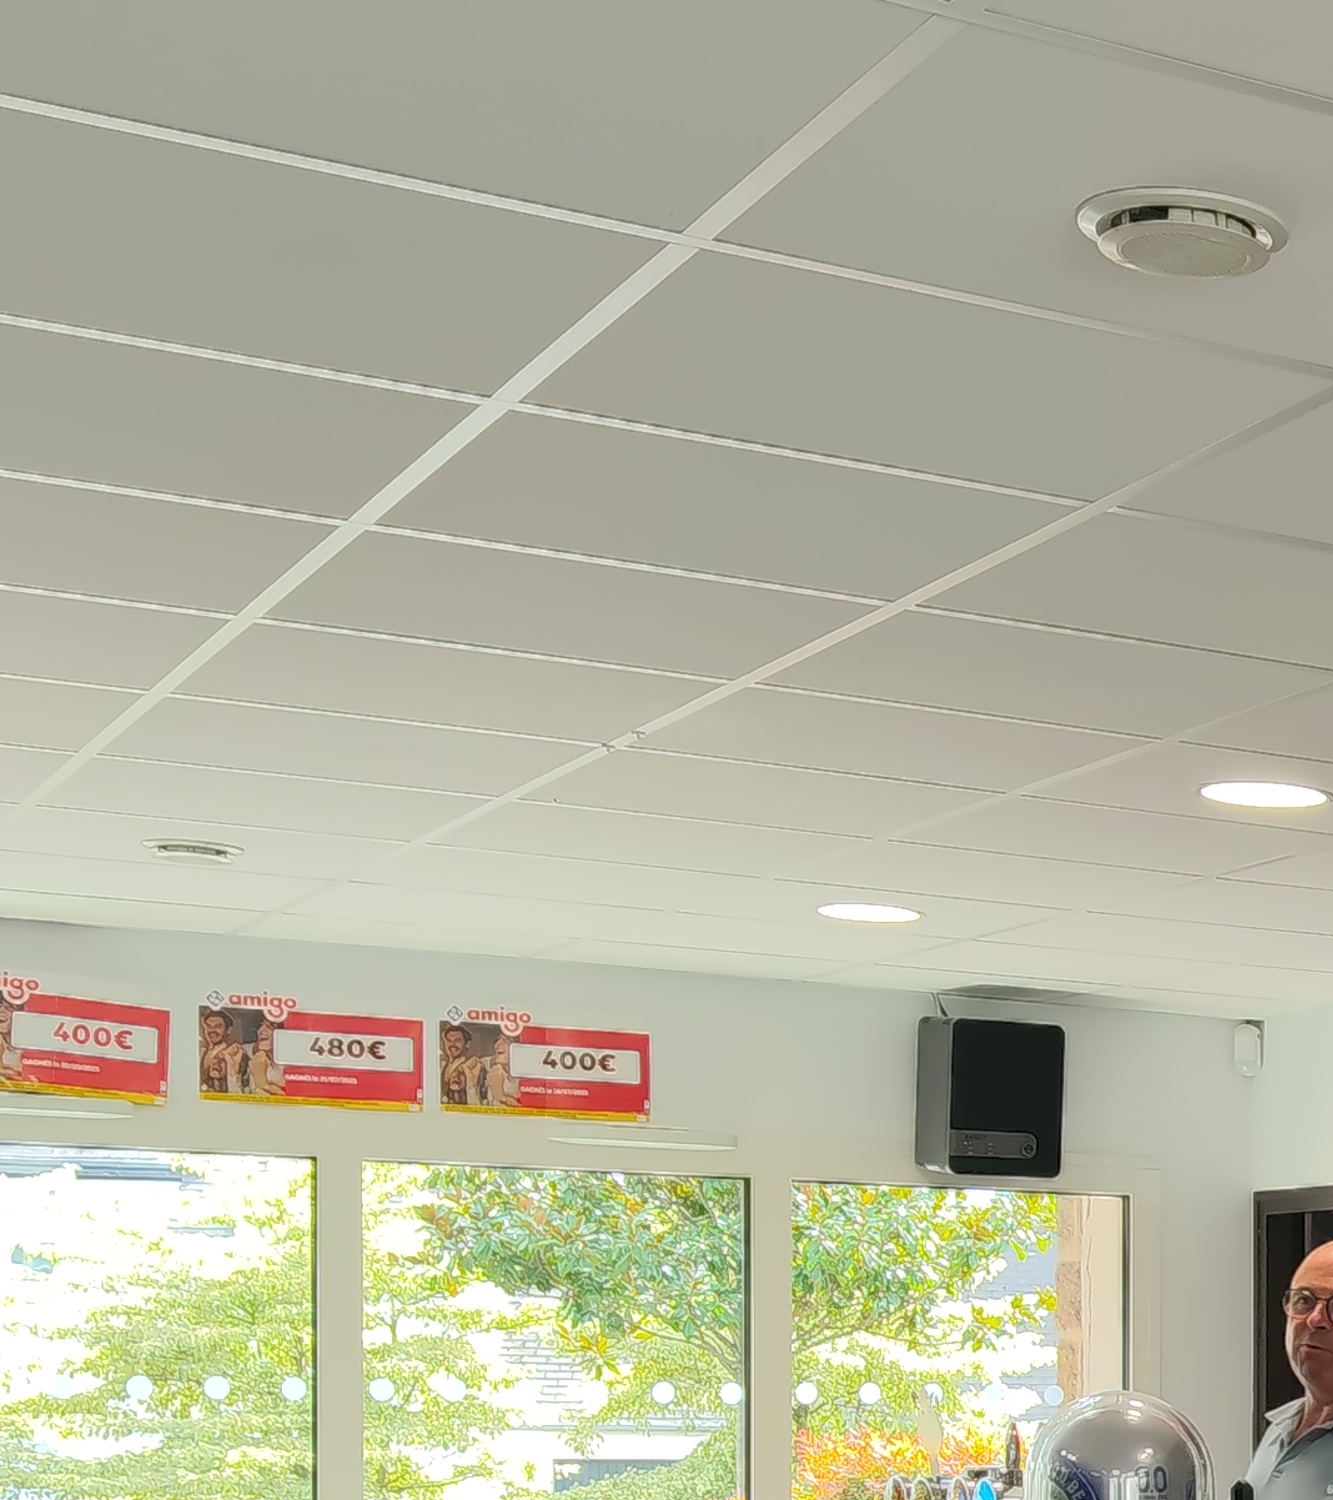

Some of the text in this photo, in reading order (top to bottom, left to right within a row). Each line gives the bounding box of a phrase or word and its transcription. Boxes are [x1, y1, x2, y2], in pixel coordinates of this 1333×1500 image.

[228, 992, 297, 1018] amigo
[467, 1007, 531, 1032] amigo
[53, 1021, 134, 1050] 400€
[309, 1037, 387, 1060] 480€
[542, 1051, 617, 1073] 400€
